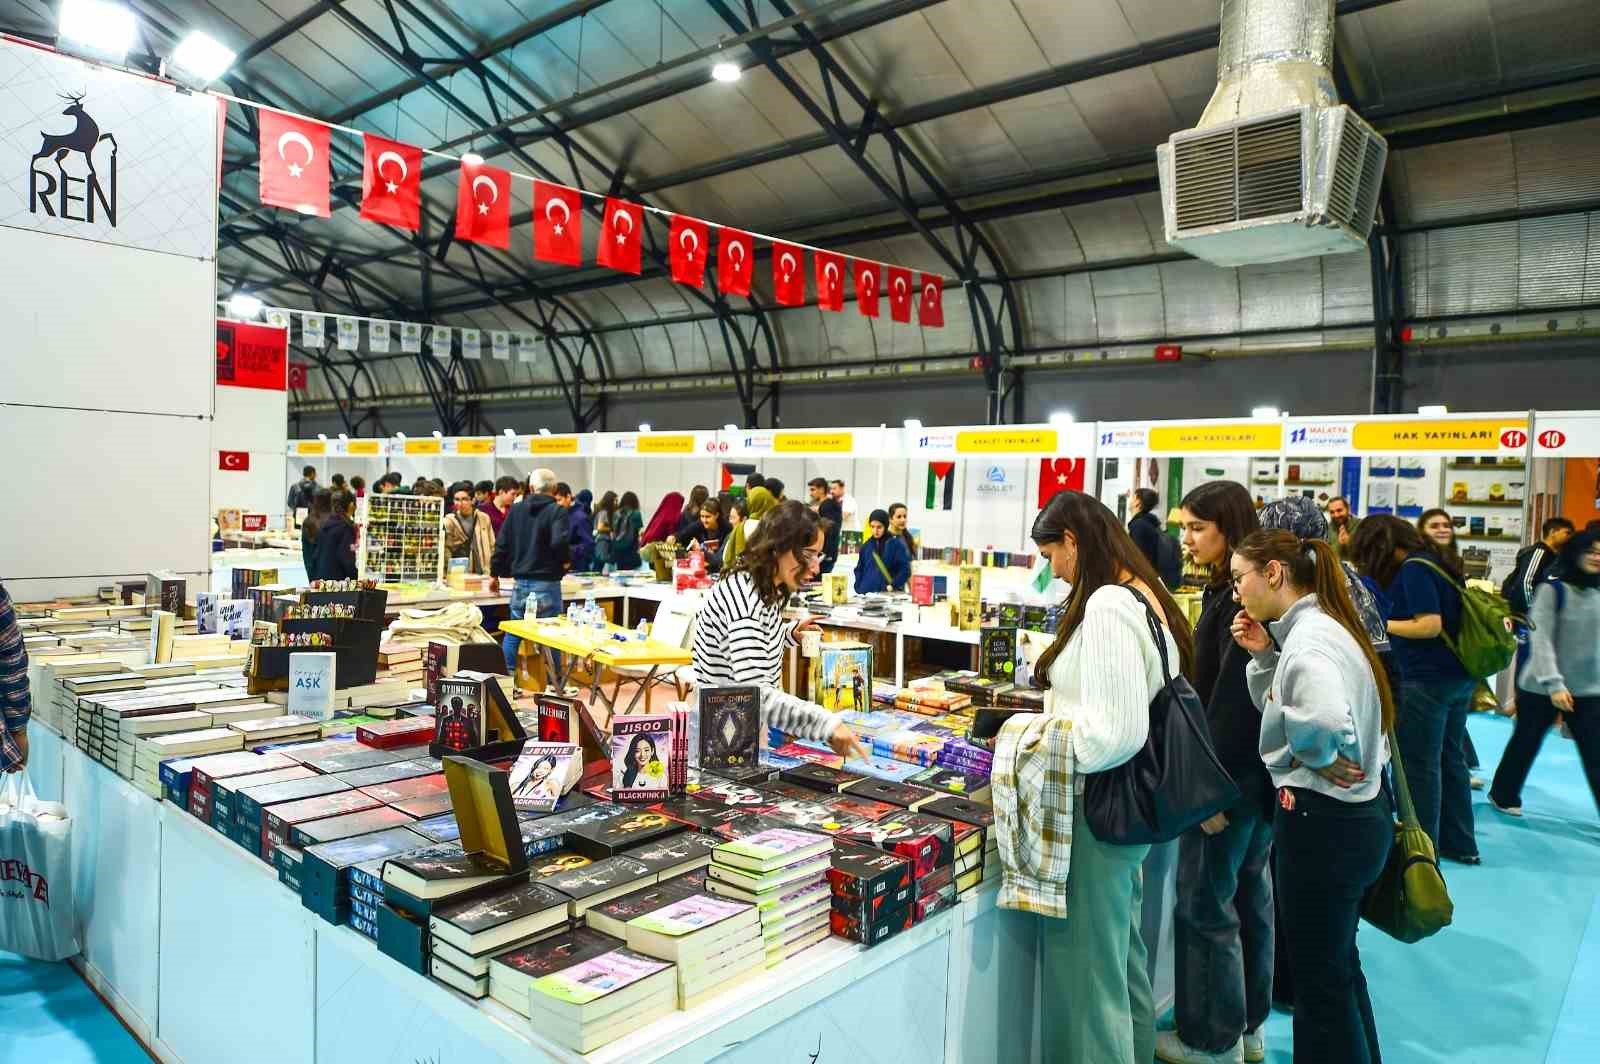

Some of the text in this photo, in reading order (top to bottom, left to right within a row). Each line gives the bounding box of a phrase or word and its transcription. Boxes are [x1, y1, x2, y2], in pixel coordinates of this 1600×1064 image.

[29, 158, 117, 228] REN
[1101, 432, 1113, 446] 11
[1291, 427, 1307, 443] 11
[1393, 430, 1493, 441] HAK YAYINLARI
[1506, 431, 1521, 448] 11
[1544, 431, 1560, 448] 10
[621, 721, 662, 734] JISOO
[526, 746, 570, 755] JENNIE
[618, 791, 659, 800] BLACKPINK
